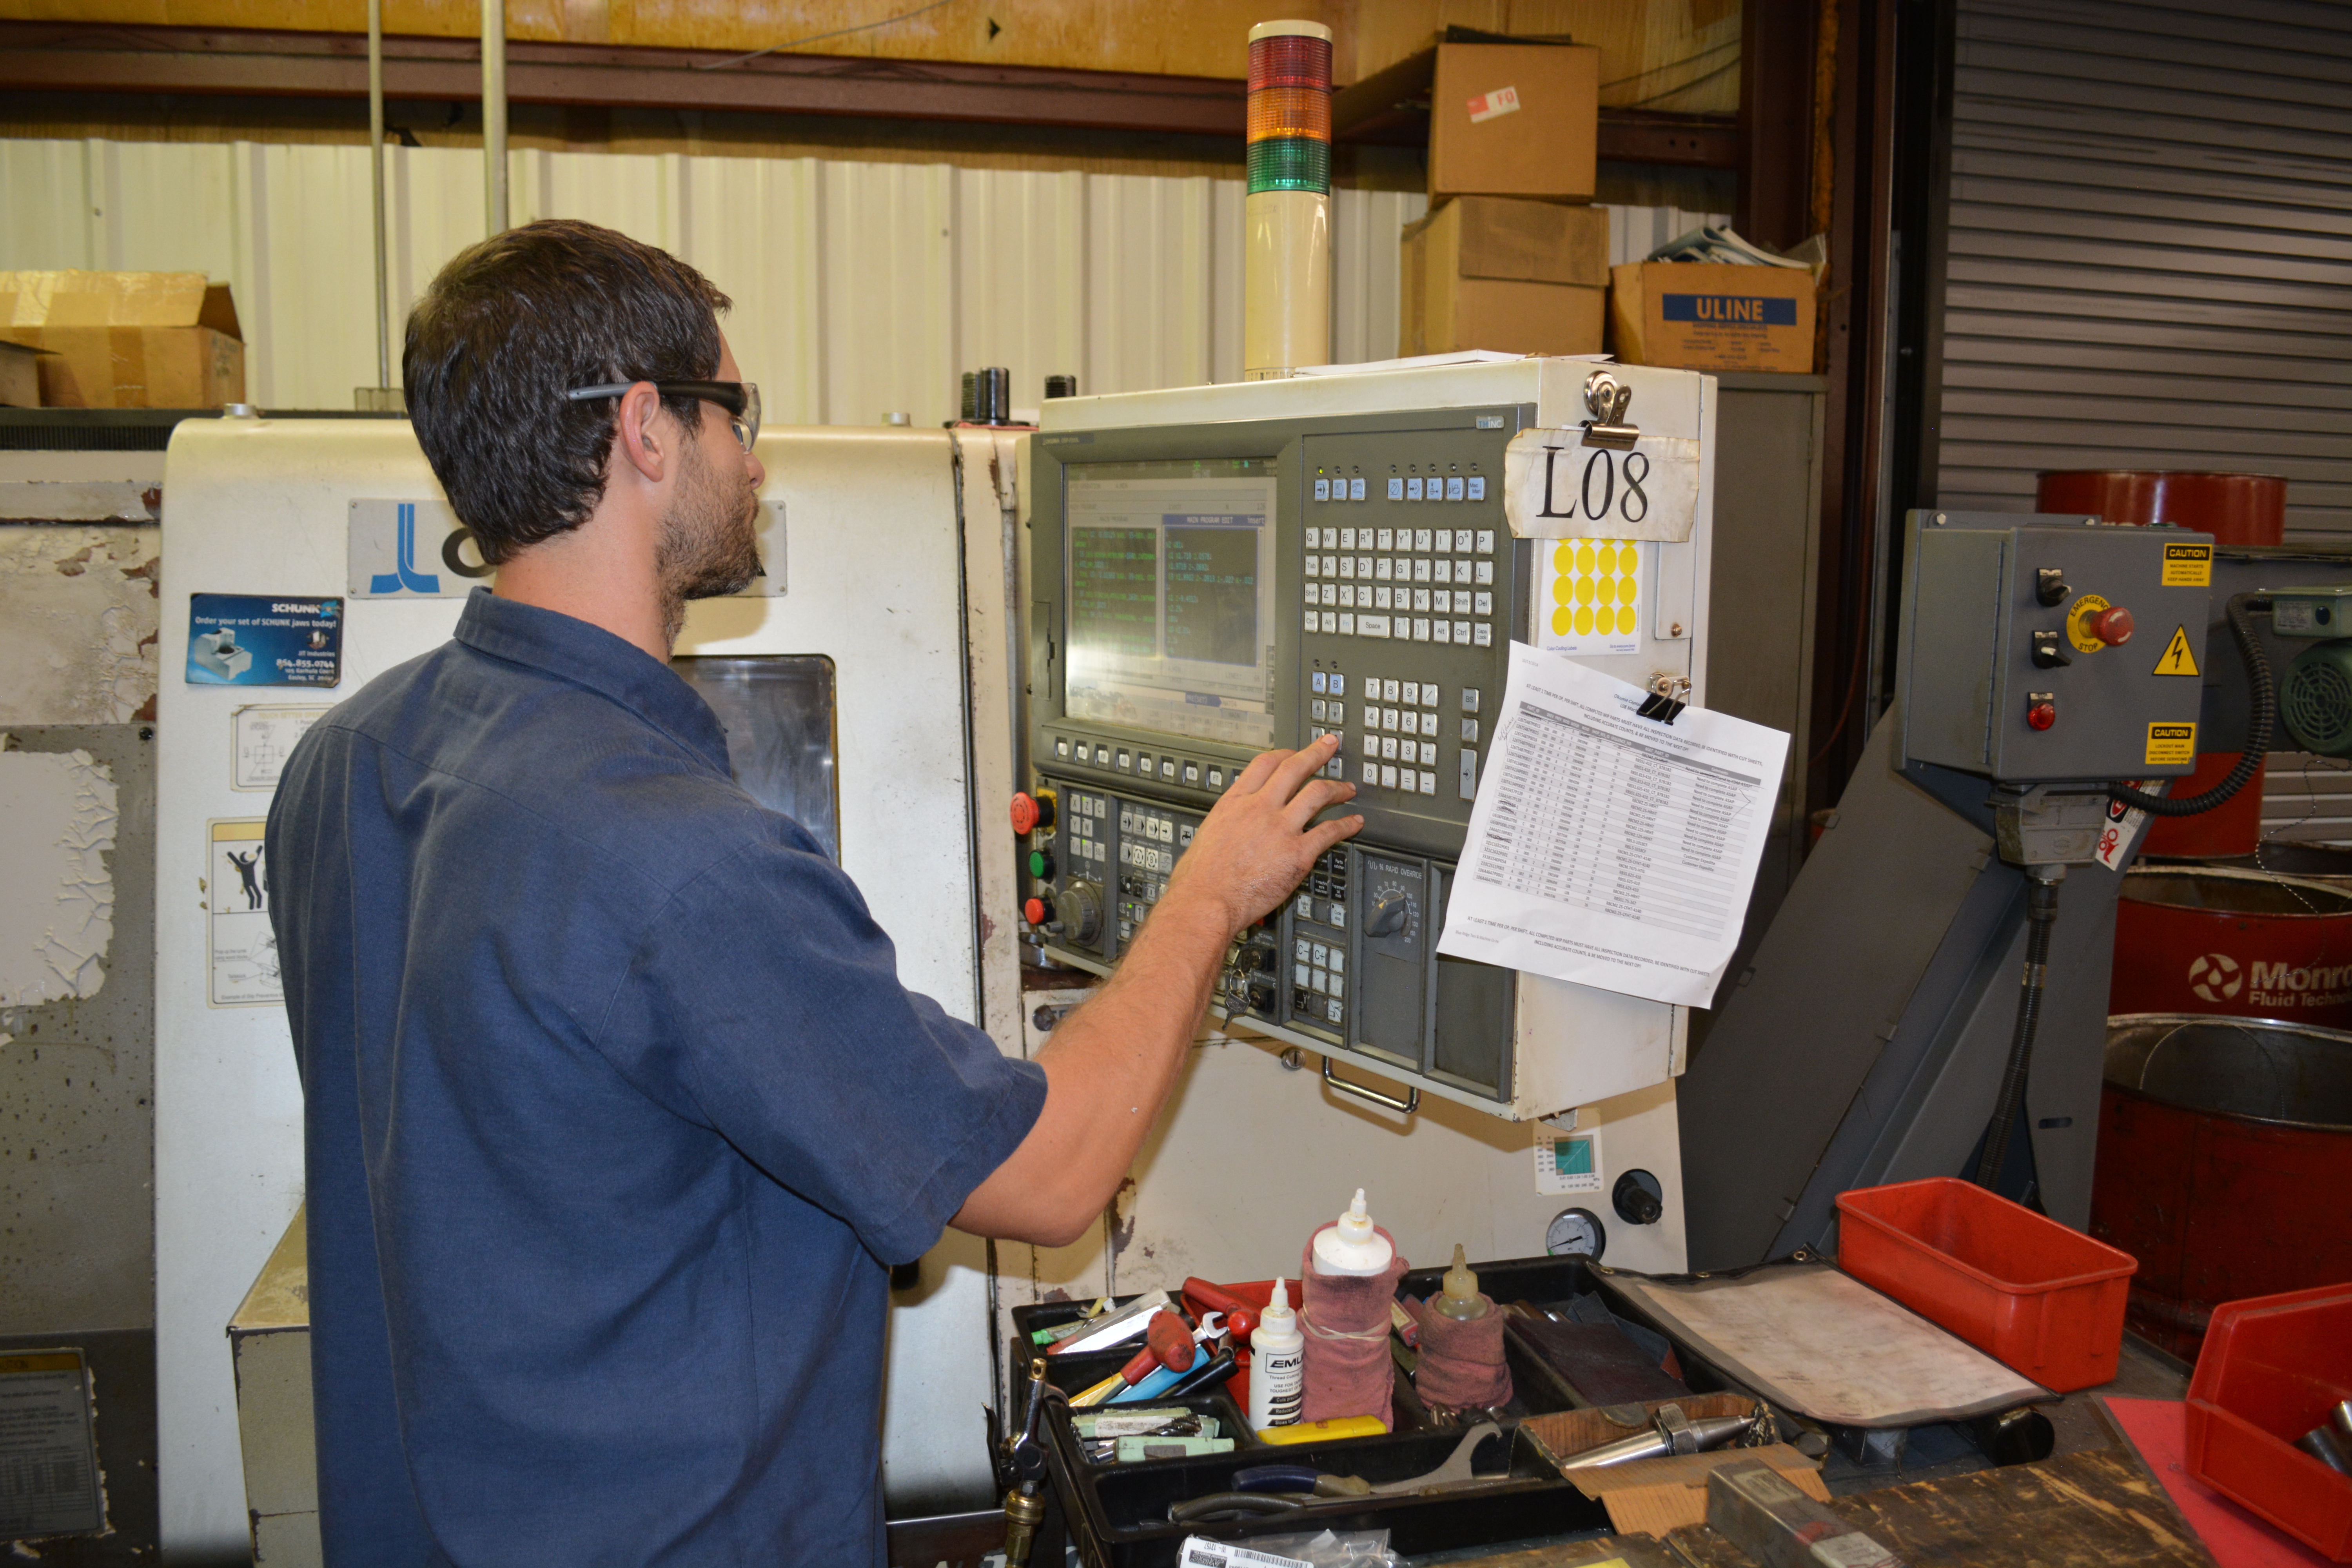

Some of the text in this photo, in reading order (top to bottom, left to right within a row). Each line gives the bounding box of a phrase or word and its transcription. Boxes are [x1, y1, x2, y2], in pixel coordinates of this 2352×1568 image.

[1697, 298, 1763, 321] ULINE
[1536, 446, 1650, 523] L08
[1247, 516, 1265, 524] insert
[1307, 533, 1312, 541] Q
[1324, 534, 1330, 542] W
[1343, 534, 1347, 542] E
[1360, 534, 1366, 543] R
[1379, 535, 1384, 543] T
[1399, 535, 1404, 543] Y
[1417, 535, 1423, 544] U
[1457, 536, 1464, 544] O
[1479, 537, 1485, 546] P
[2169, 549, 2206, 557] CAUTION
[1342, 563, 1347, 571] S
[1359, 563, 1365, 571] D
[1379, 564, 1383, 572] F
[1397, 564, 1403, 573] G
[1417, 566, 1422, 574] H
[1437, 566, 1442, 575] J
[1457, 567, 1463, 575] K
[1479, 568, 1483, 577] L
[1324, 590, 1328, 598] Z
[1341, 591, 1346, 599] X
[1359, 592, 1365, 601] C
[1377, 593, 1383, 601] V
[1397, 594, 1402, 603] B
[1416, 595, 1421, 604] N
[1436, 596, 1442, 605] M
[272, 603, 321, 613] SCHUNK
[2070, 596, 2111, 617] EMERGENC
[195, 616, 216, 624] Order
[218, 618, 236, 627] your
[251, 618, 260, 626] of
[261, 619, 291, 627] SCHUNK
[291, 619, 310, 628] jaws
[312, 619, 337, 629] today!
[2078, 642, 2098, 652] STOP
[1370, 684, 1374, 692] 7
[1388, 686, 1393, 694] 8
[1407, 688, 1412, 697] 9
[1614, 693, 1628, 703] Okuma
[1368, 713, 1374, 721] 4
[1388, 715, 1392, 723] 5
[1406, 717, 1411, 726] 6
[1570, 699, 1579, 708] SHIFT,
[1610, 714, 1621, 722] PARTS
[1632, 722, 1642, 730] HAVE
[1650, 729, 1673, 740] INSPECTION
[1706, 746, 1727, 756] IDENTIFIED
[1748, 758, 1763, 767] SHEETS,
[1387, 744, 1392, 752] 2
[1405, 746, 1410, 755] 3
[1710, 780, 1727, 789] complete
[1683, 854, 1700, 862] Customer
[1386, 865, 1398, 874] RAPID
[1401, 868, 1422, 879] OVERRIDE
[1315, 950, 1325, 960] C+
[2250, 961, 2352, 991] Monro
[2249, 991, 2295, 1007] Fluid
[1270, 1354, 1303, 1368] EMU
